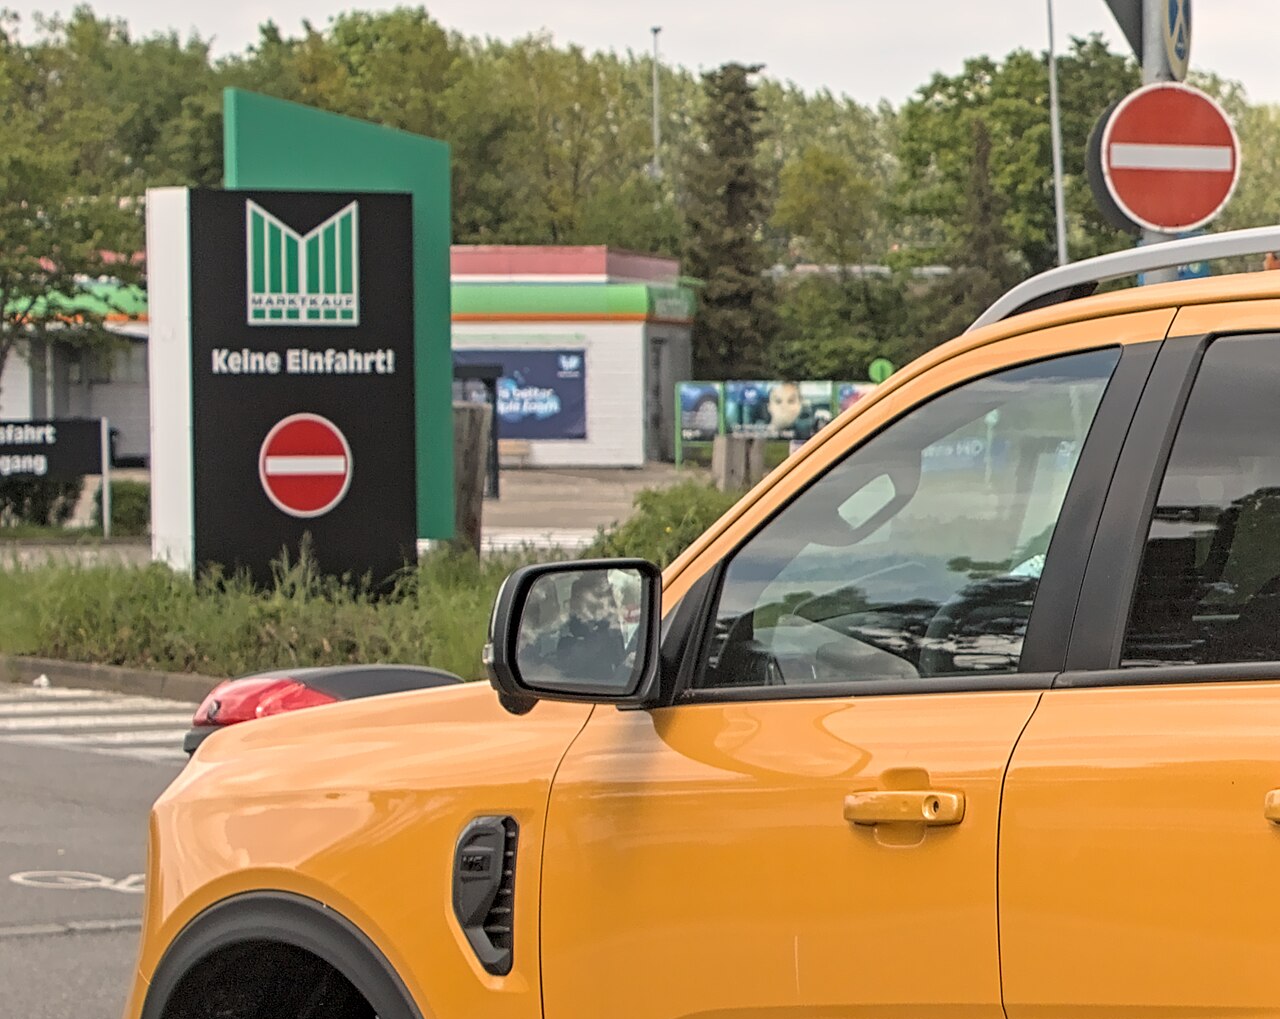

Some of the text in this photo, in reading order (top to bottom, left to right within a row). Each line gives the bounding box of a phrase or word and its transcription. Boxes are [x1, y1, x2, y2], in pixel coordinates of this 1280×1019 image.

[251, 297, 353, 306] MARKTKAUF
[212, 348, 395, 374] Keine Einfahrt!
[0, 454, 48, 476] gang
